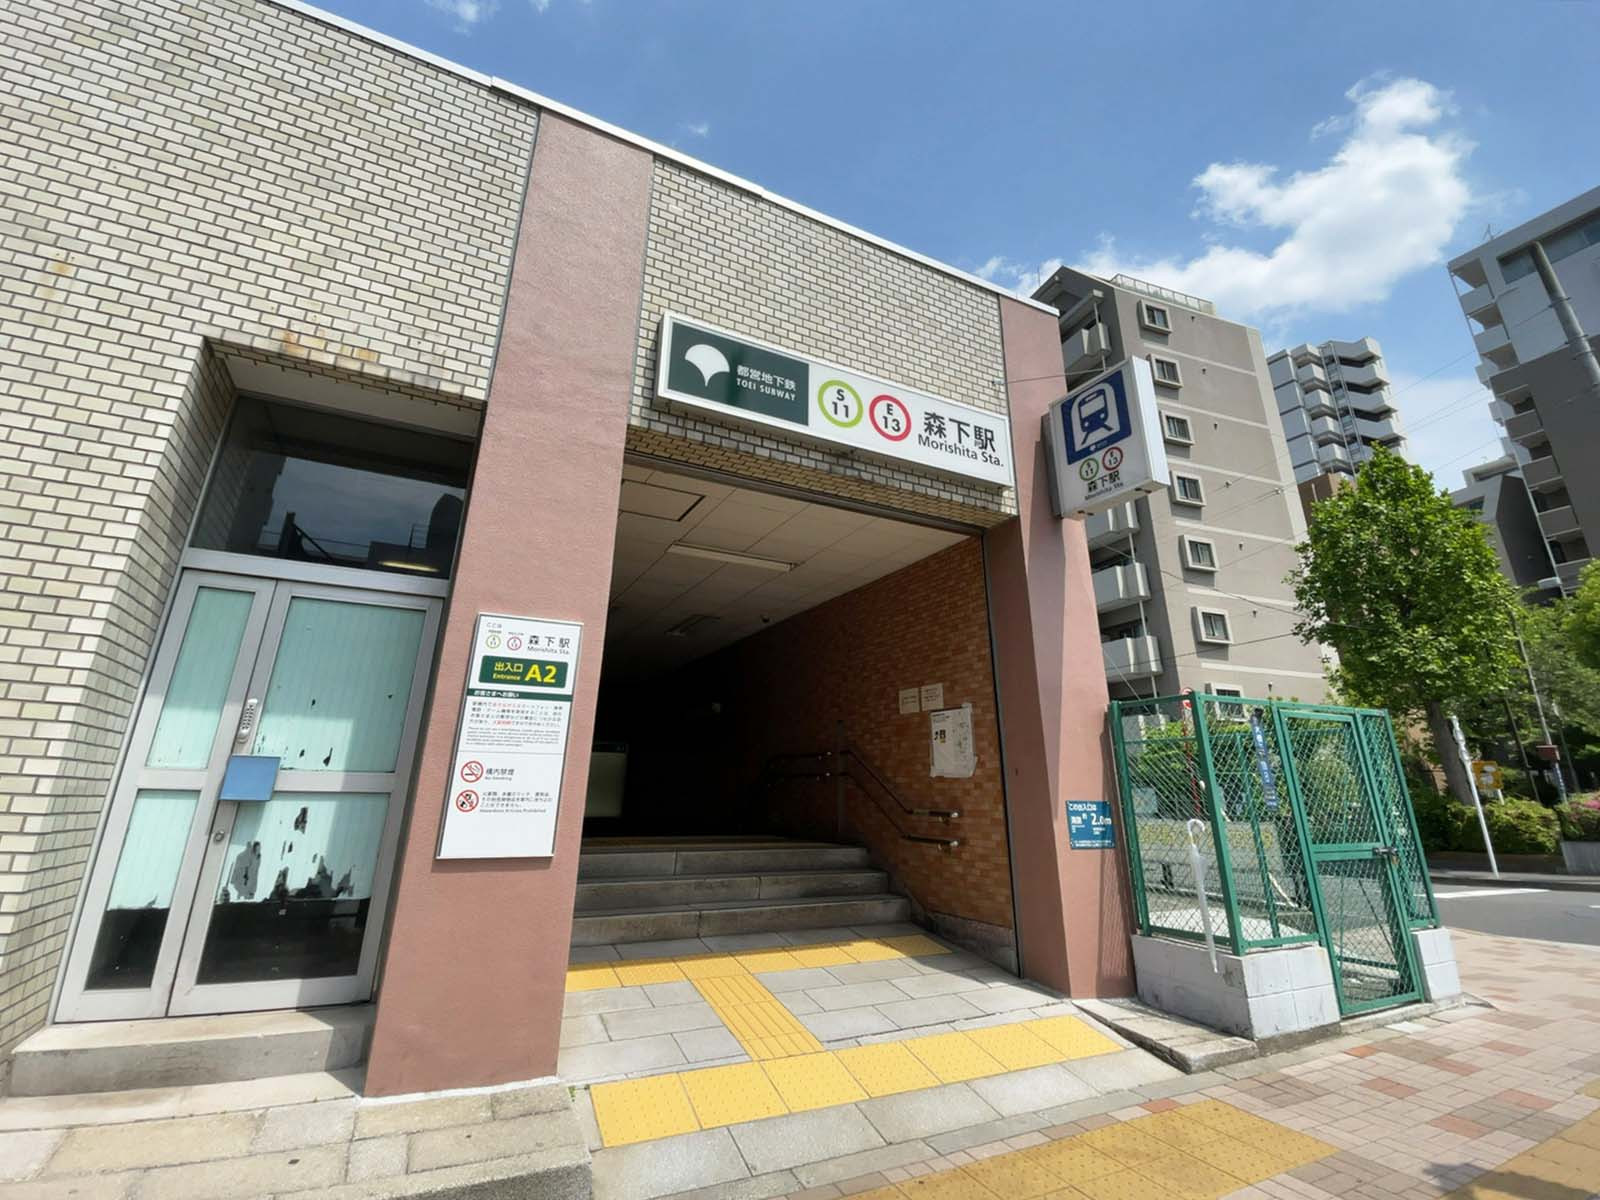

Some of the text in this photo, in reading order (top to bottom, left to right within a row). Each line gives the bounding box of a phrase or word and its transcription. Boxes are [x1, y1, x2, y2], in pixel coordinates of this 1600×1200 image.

[736, 365, 797, 392] 都営地下鉄
[737, 378, 797, 402] TOEI SUBWAY
[836, 388, 846, 401] S
[831, 401, 851, 420] 11
[886, 403, 895, 417] E
[881, 415, 902, 433] 13
[923, 410, 996, 454] 森下駅
[917, 434, 1005, 468] Morishita Sta.
[1087, 470, 1121, 493] 森下駅
[528, 635, 571, 649] 森下駅
[492, 673, 521, 681] Entrance
[494, 662, 558, 684] 出入口 A2
